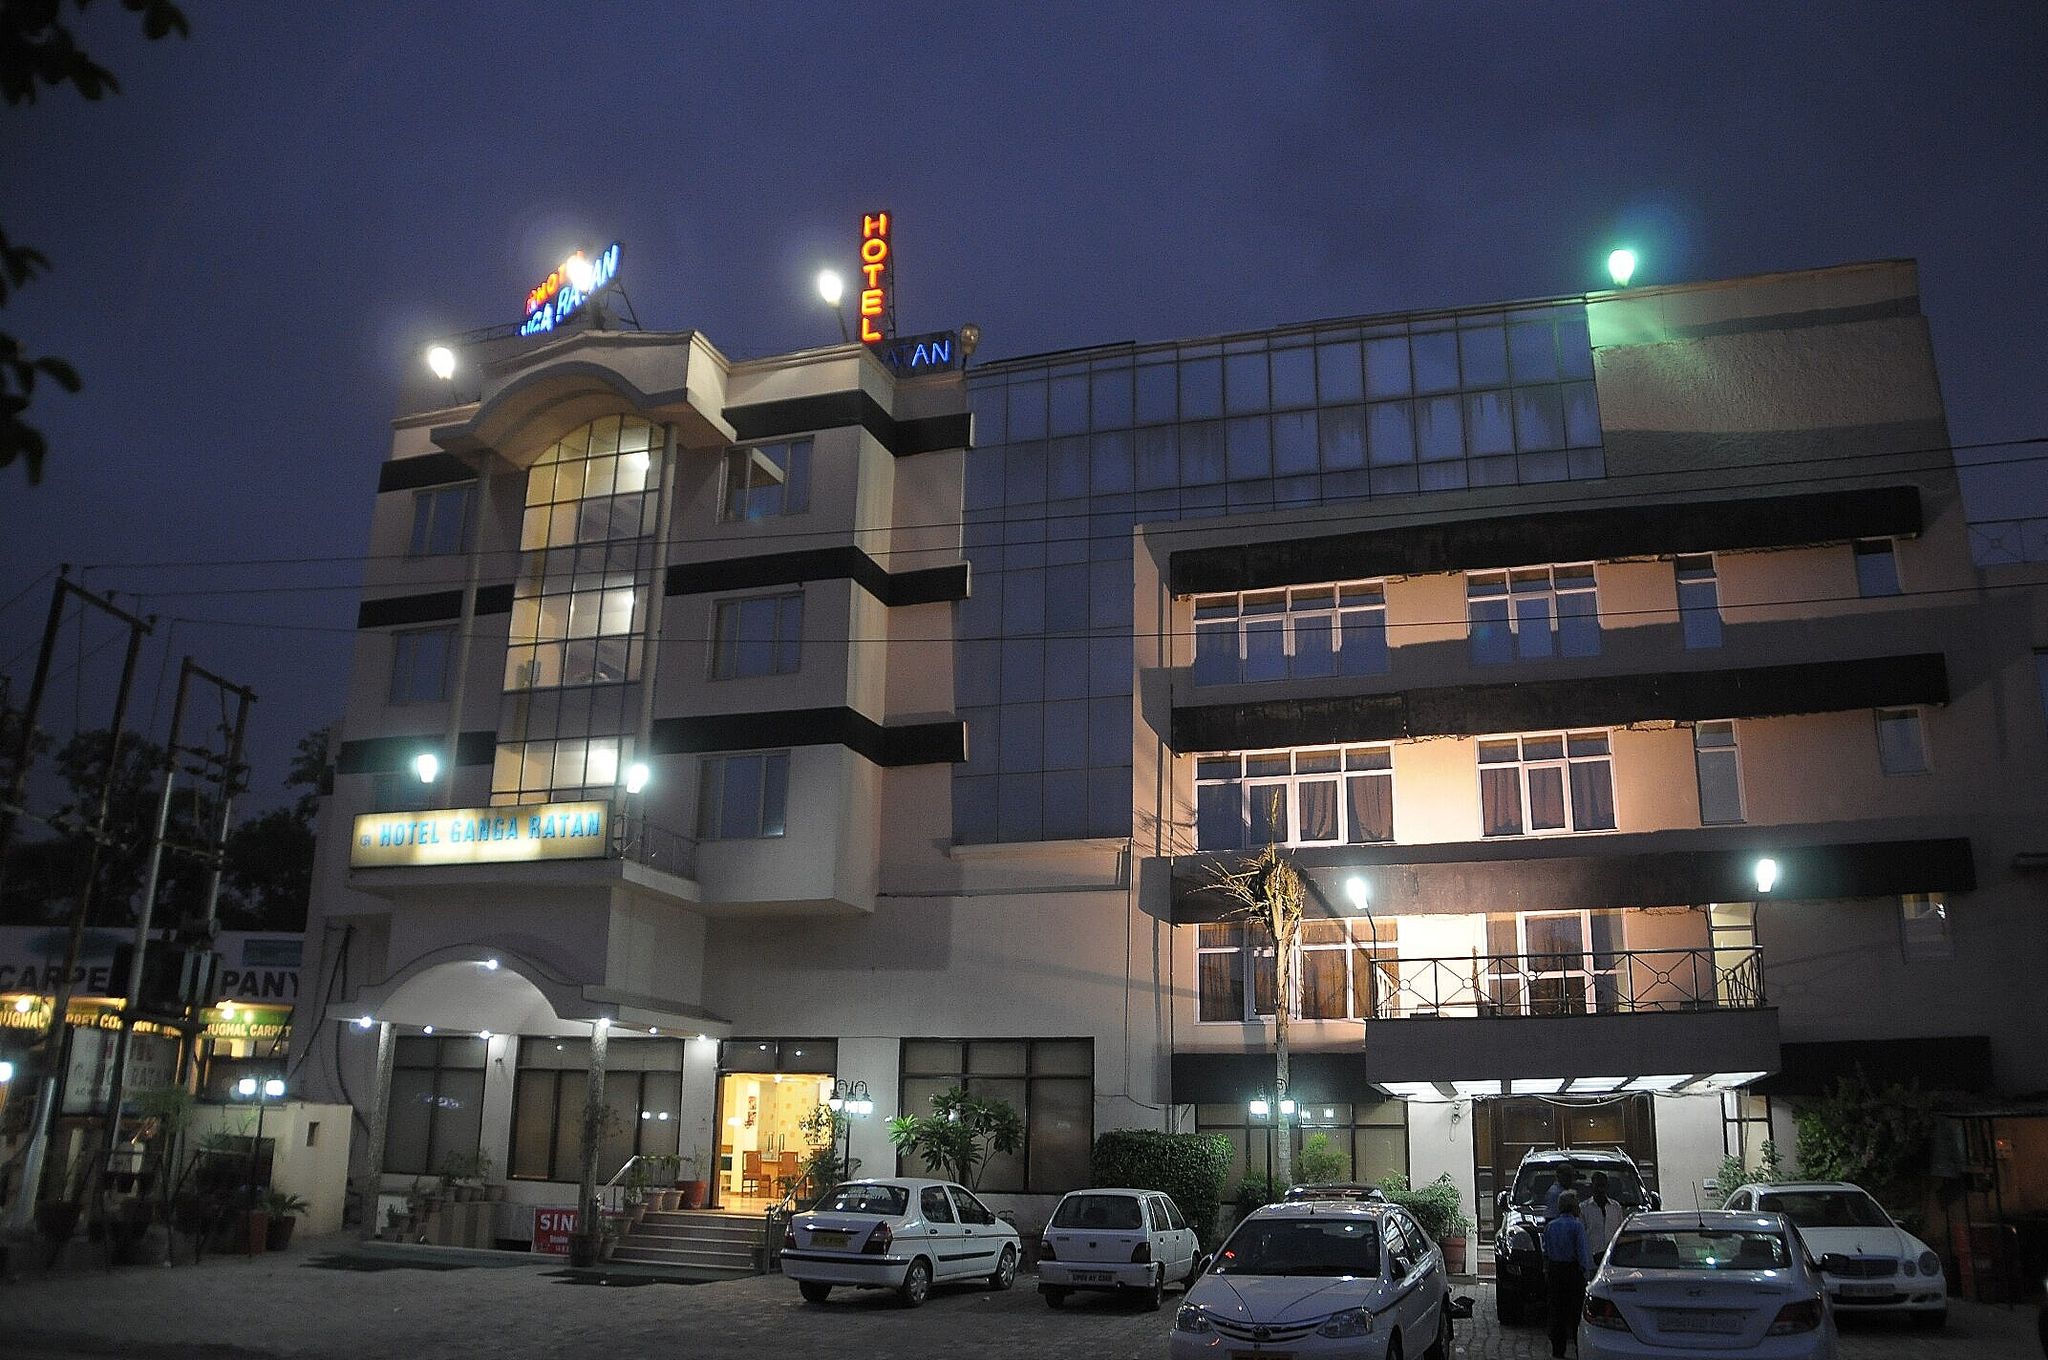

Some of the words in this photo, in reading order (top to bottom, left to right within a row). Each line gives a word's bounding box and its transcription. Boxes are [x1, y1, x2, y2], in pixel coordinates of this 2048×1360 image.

[861, 213, 888, 343] HOTEL
[379, 821, 440, 846] HOTEL
[450, 816, 518, 843] GANGA
[528, 811, 600, 839] RATAN
[540, 1213, 578, 1232] SIN
